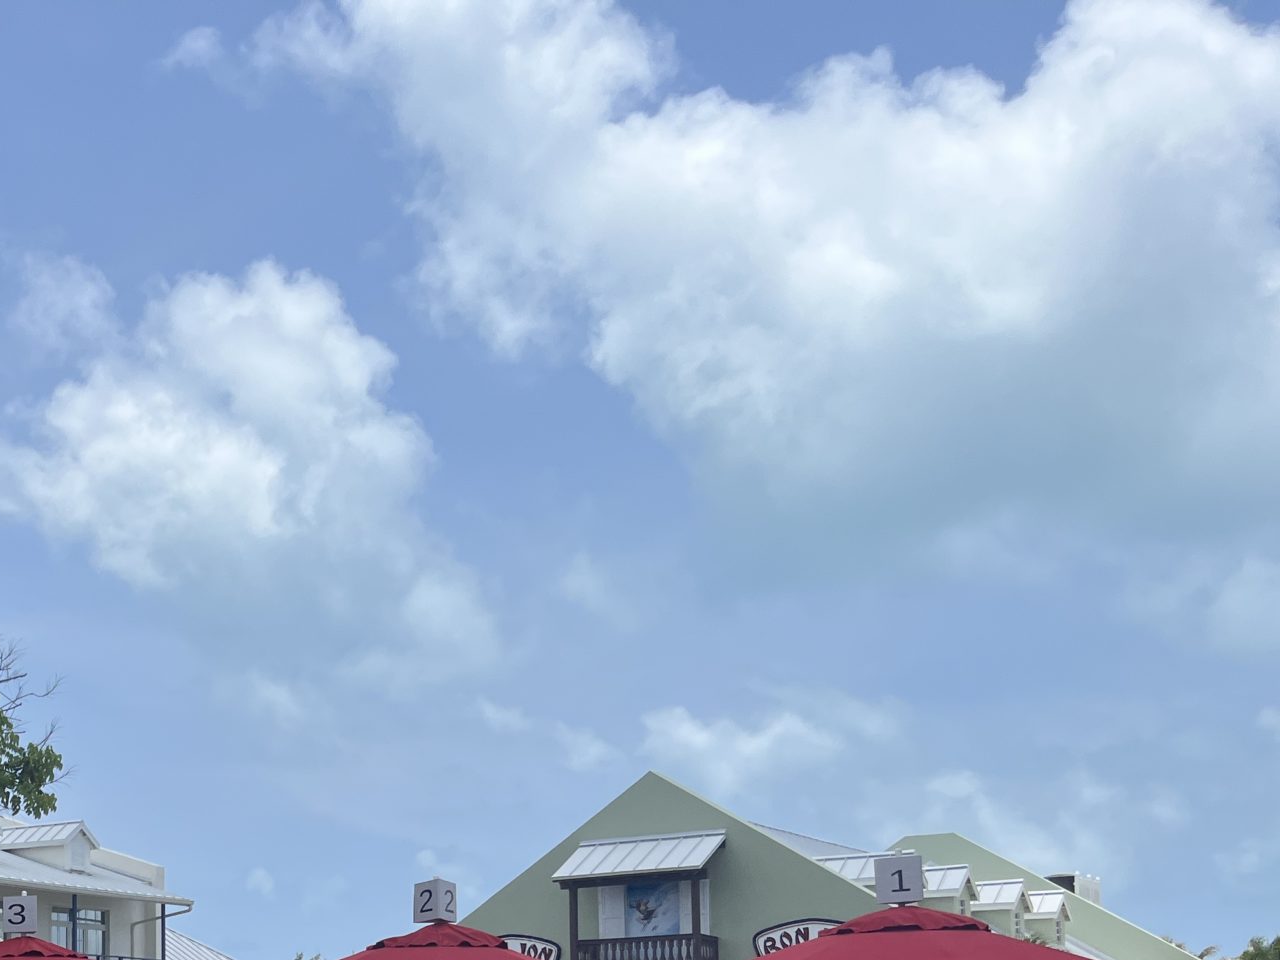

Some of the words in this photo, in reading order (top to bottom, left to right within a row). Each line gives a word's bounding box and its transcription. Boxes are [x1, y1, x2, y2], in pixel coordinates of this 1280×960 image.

[891, 869, 911, 892] 1
[420, 889, 433, 913] 2
[444, 889, 454, 913] 2
[8, 903, 26, 925] 3
[763, 926, 809, 955] RON
